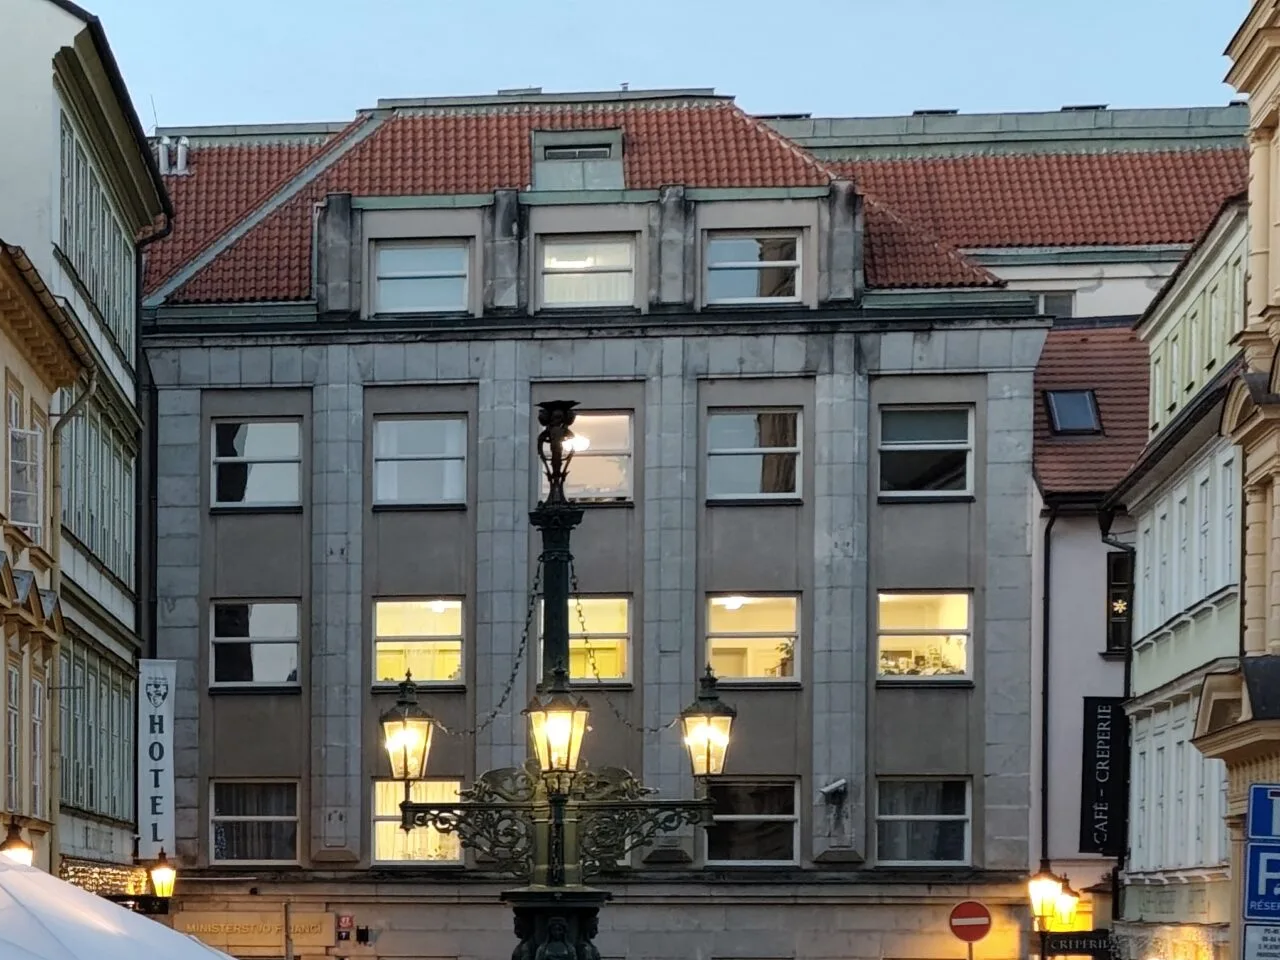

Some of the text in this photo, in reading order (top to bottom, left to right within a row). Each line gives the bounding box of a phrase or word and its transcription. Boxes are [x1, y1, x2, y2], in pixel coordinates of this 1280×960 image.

[148, 714, 165, 842] HOTEL
[1095, 704, 1112, 783] CREPERIE
[275, 919, 323, 935] FNANCÍ
